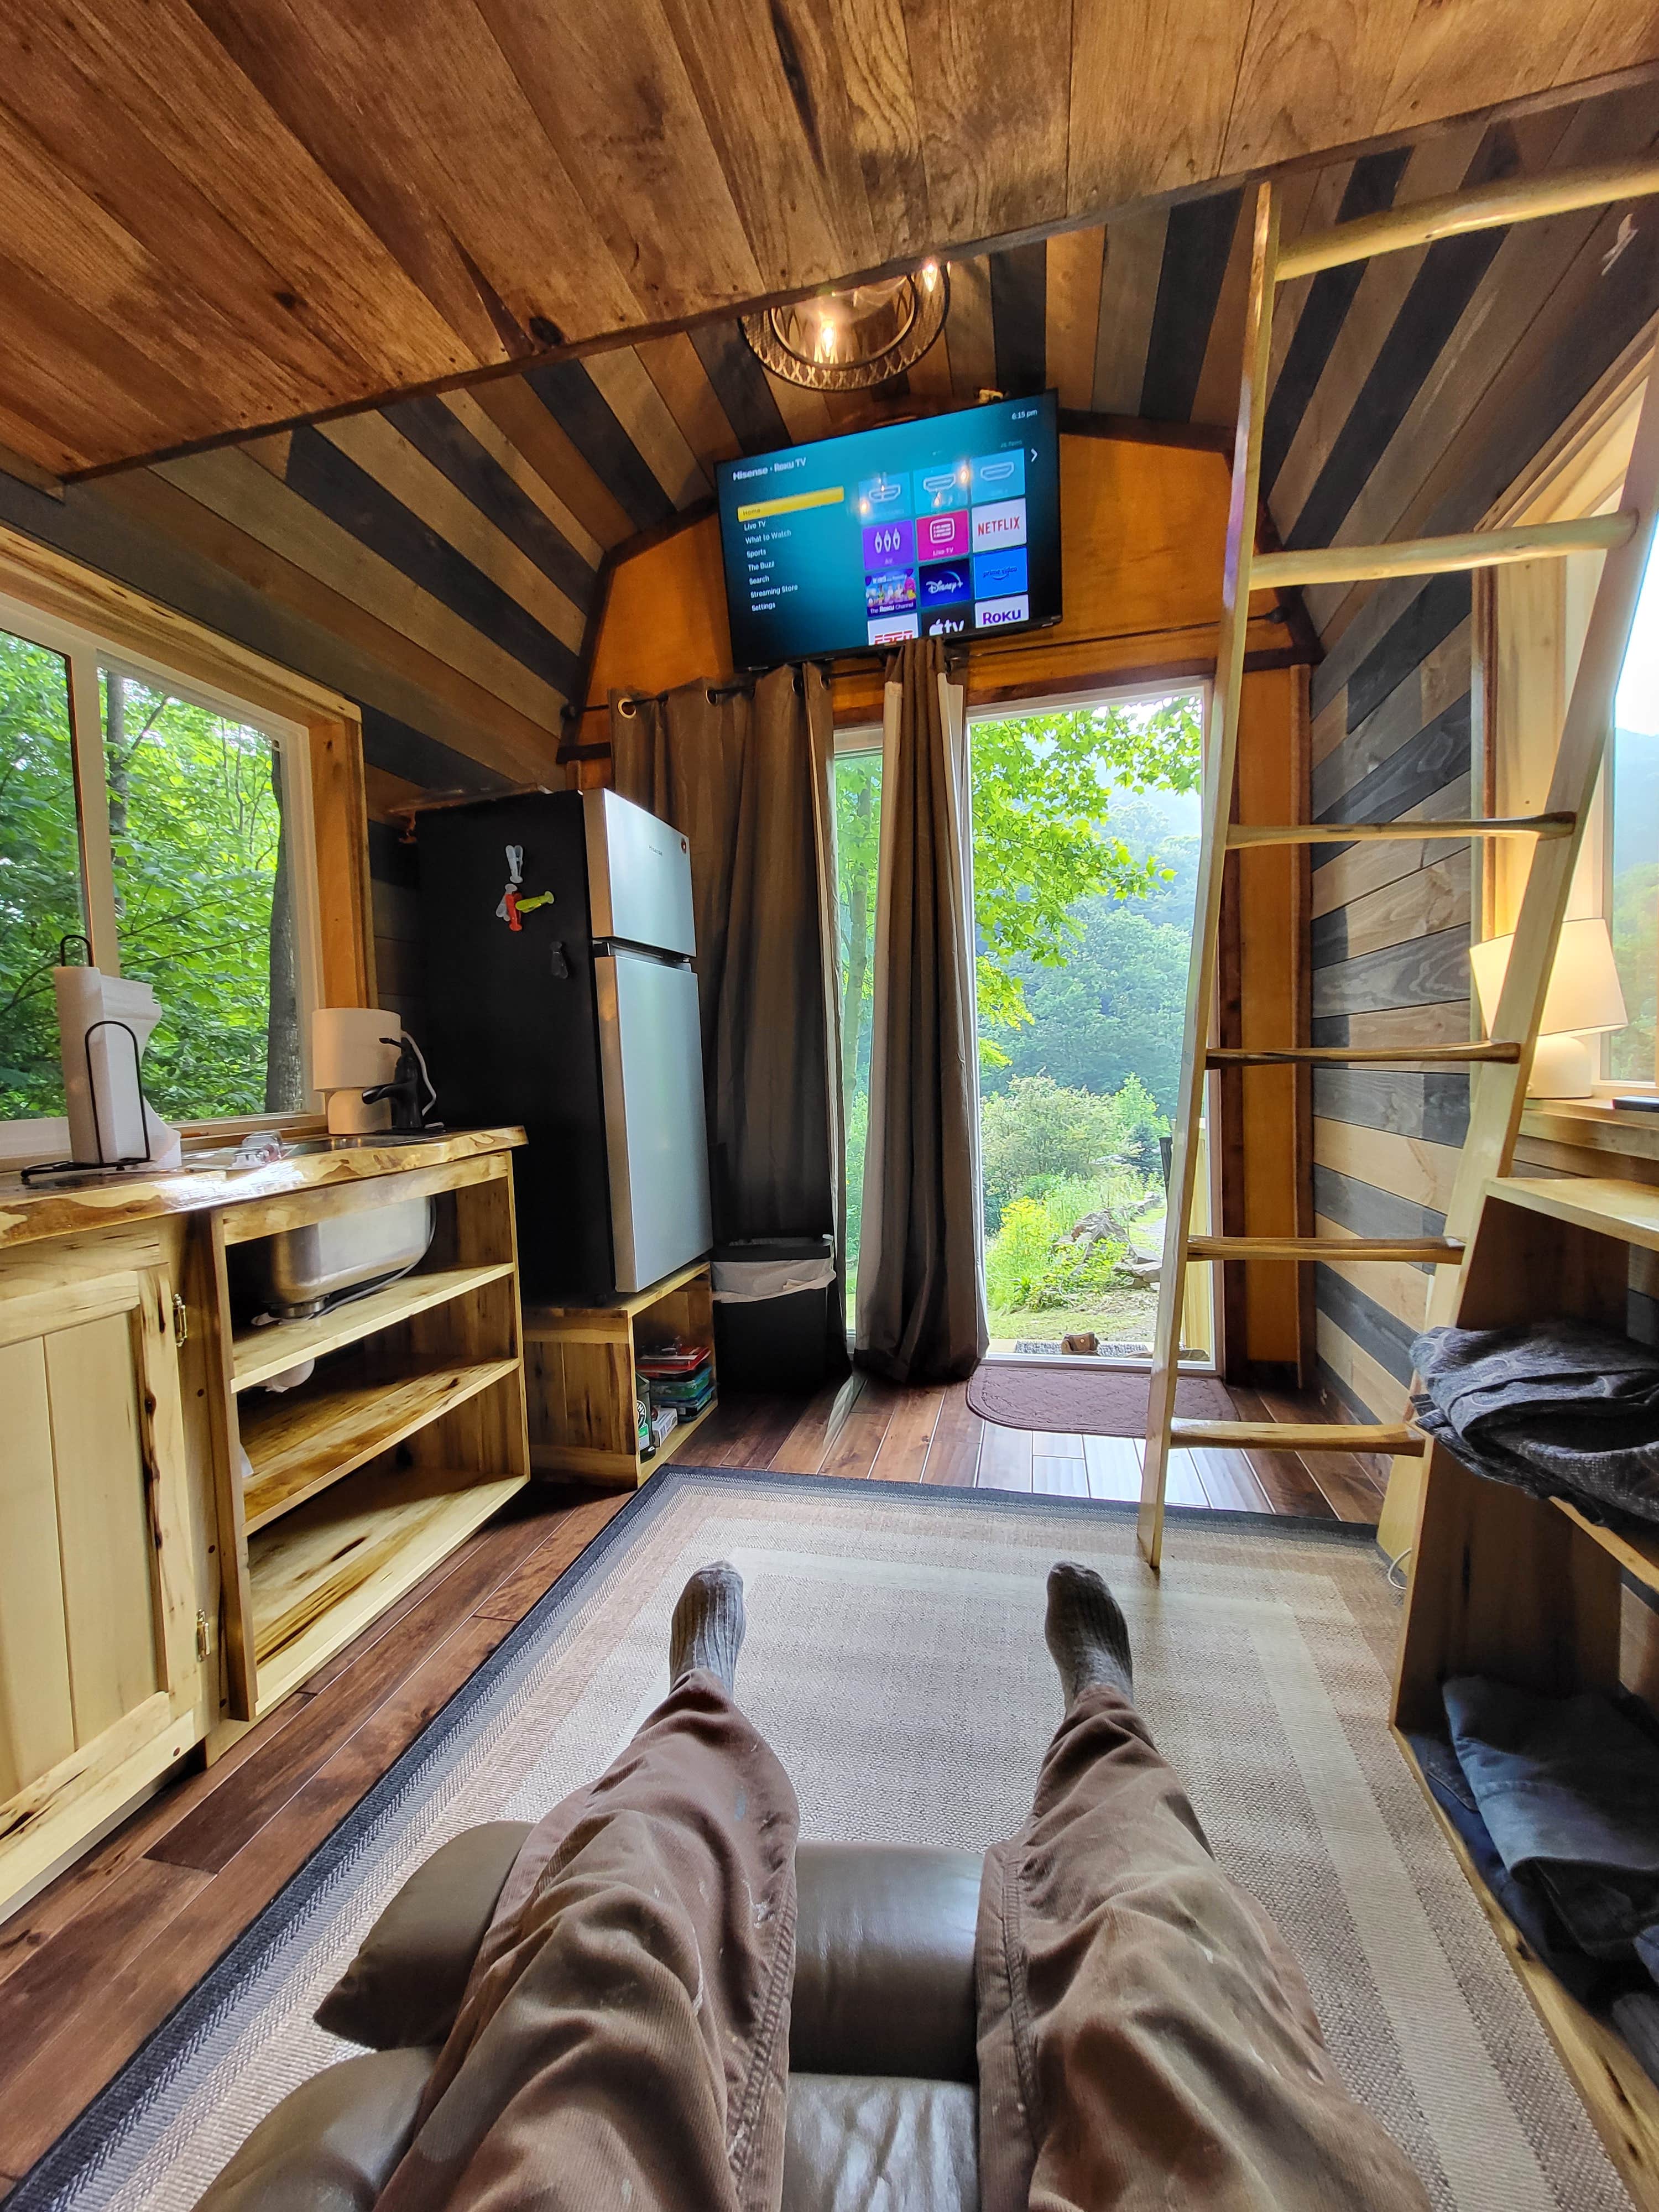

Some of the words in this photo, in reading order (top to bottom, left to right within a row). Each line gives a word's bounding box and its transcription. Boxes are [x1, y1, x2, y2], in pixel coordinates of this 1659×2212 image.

[1026, 409, 1037, 419] pm
[733, 467, 768, 481] Hisense
[795, 457, 806, 467] TV
[744, 523, 757, 531] Live
[758, 520, 766, 529] TV
[978, 516, 1020, 536] NETFLIX
[745, 535, 761, 545] What
[763, 534, 770, 542] to
[771, 529, 792, 540] Watch
[747, 549, 766, 559] Sports
[748, 563, 759, 572] The
[749, 575, 770, 586] Search
[750, 587, 781, 599] Streaming
[781, 584, 798, 593] Store
[752, 602, 776, 612] Settings
